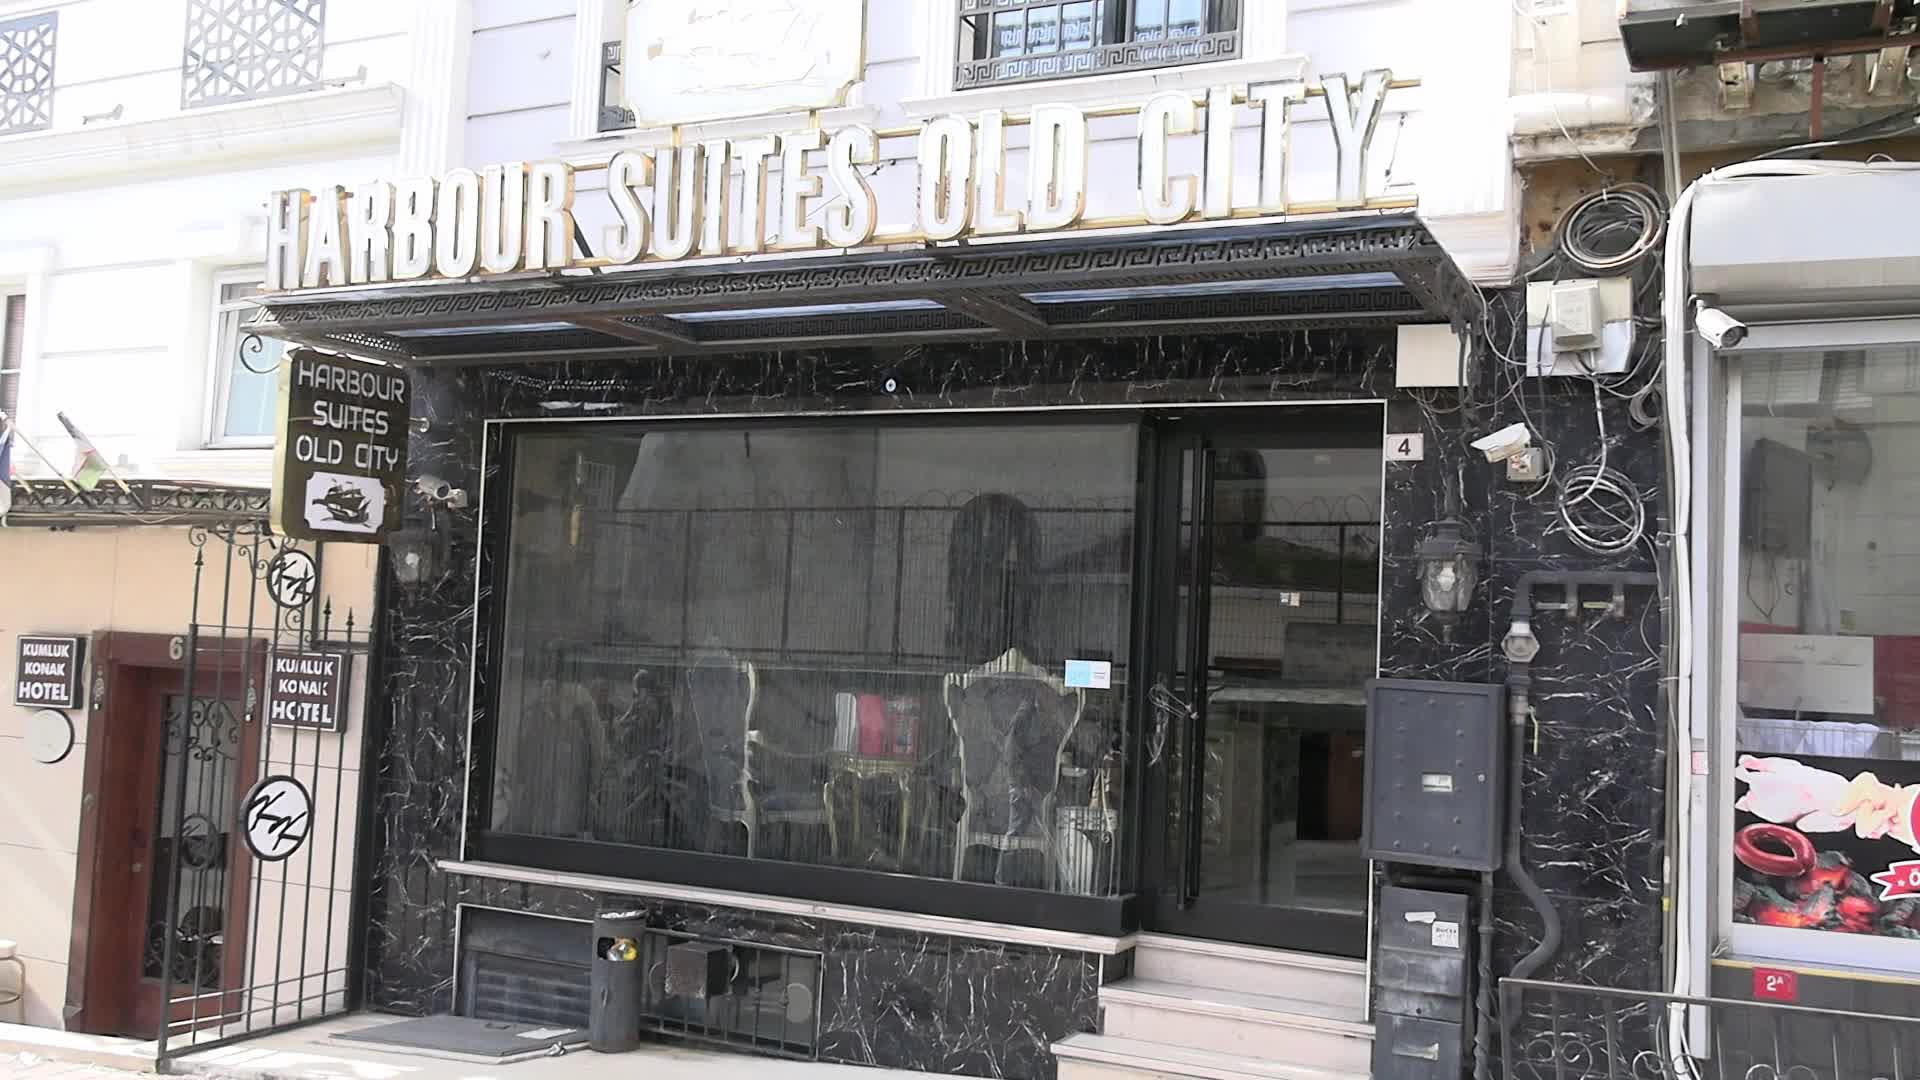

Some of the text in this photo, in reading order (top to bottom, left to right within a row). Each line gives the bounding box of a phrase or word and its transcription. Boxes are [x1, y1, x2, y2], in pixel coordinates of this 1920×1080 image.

[265, 68, 1392, 290] HARBOUR SUITES OLD CITY
[299, 359, 405, 403] HARBOUR
[313, 400, 389, 435] SUITES
[295, 434, 399, 471] OLD CITY
[1397, 438, 1411, 456] 4
[22, 643, 70, 658] KUMLUK
[169, 636, 184, 660] 6
[24, 661, 66, 677] KONAK
[276, 658, 334, 676] KUMLUK
[18, 681, 69, 701] HOTEL
[279, 678, 329, 697] KONAK
[272, 700, 332, 723] HOTEL
